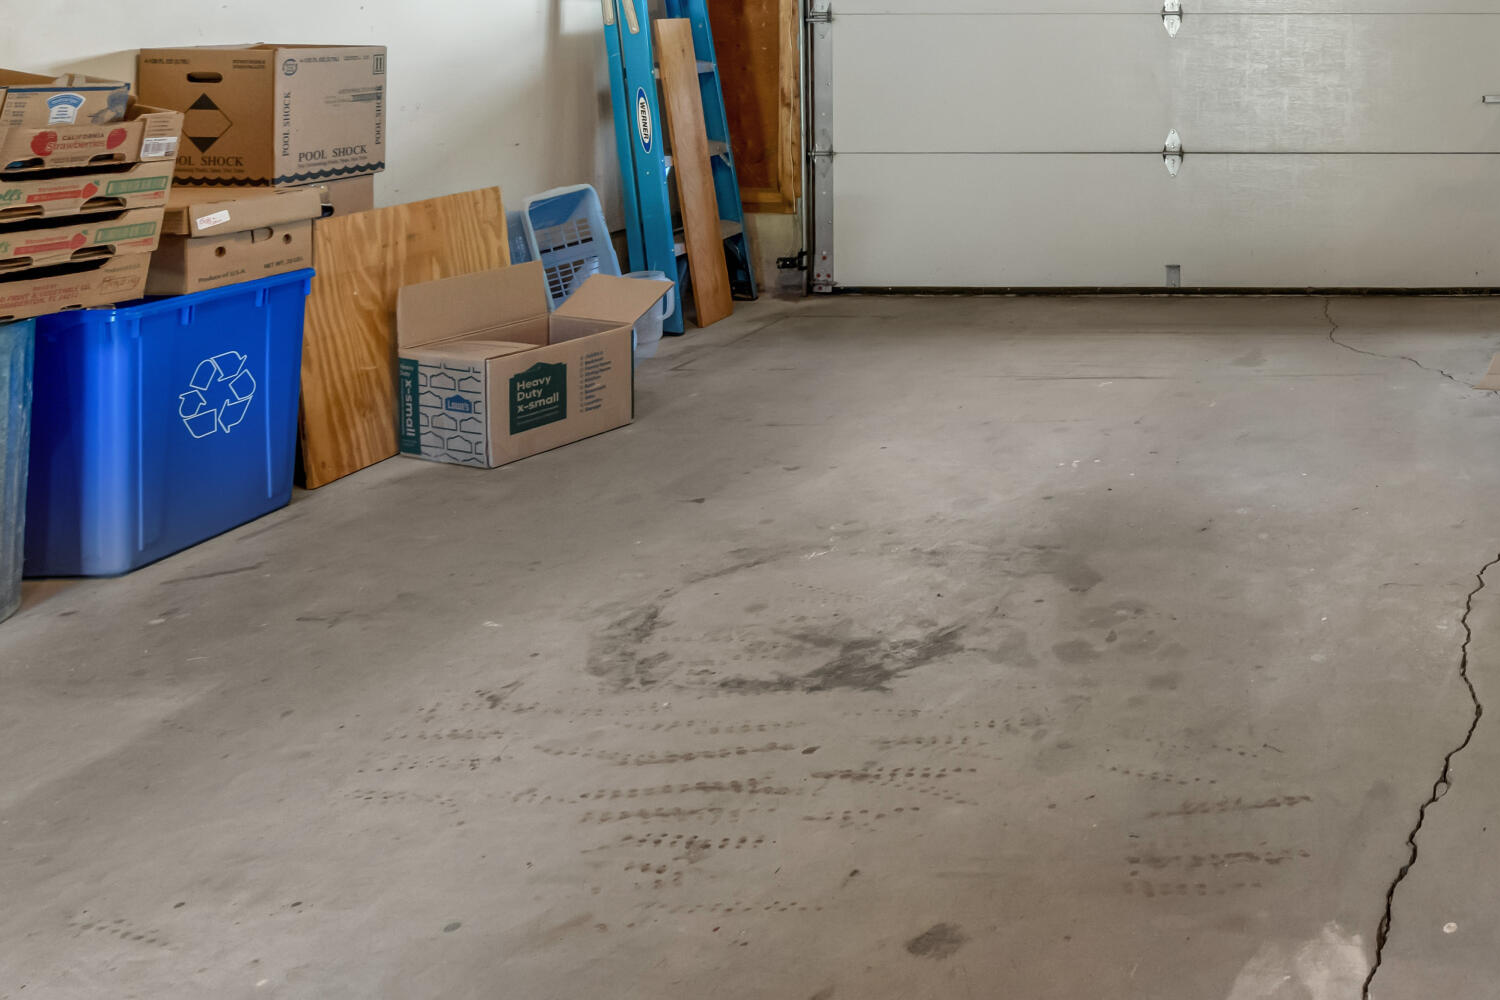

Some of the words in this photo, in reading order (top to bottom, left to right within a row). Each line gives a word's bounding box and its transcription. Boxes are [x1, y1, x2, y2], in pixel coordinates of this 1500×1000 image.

[283, 92, 291, 127] SHOCK
[639, 101, 650, 142] WERNER
[62, 132, 105, 141] CALIFORNIA
[282, 131, 290, 157] POOL
[176, 156, 195, 166] OL
[201, 155, 244, 167] SHOCK
[298, 149, 328, 162] POOL
[332, 144, 368, 158] SHOCK
[516, 375, 551, 391] Heavy
[516, 391, 560, 413] x-small
[517, 388, 543, 402] Duty
[405, 379, 416, 437] x-small
